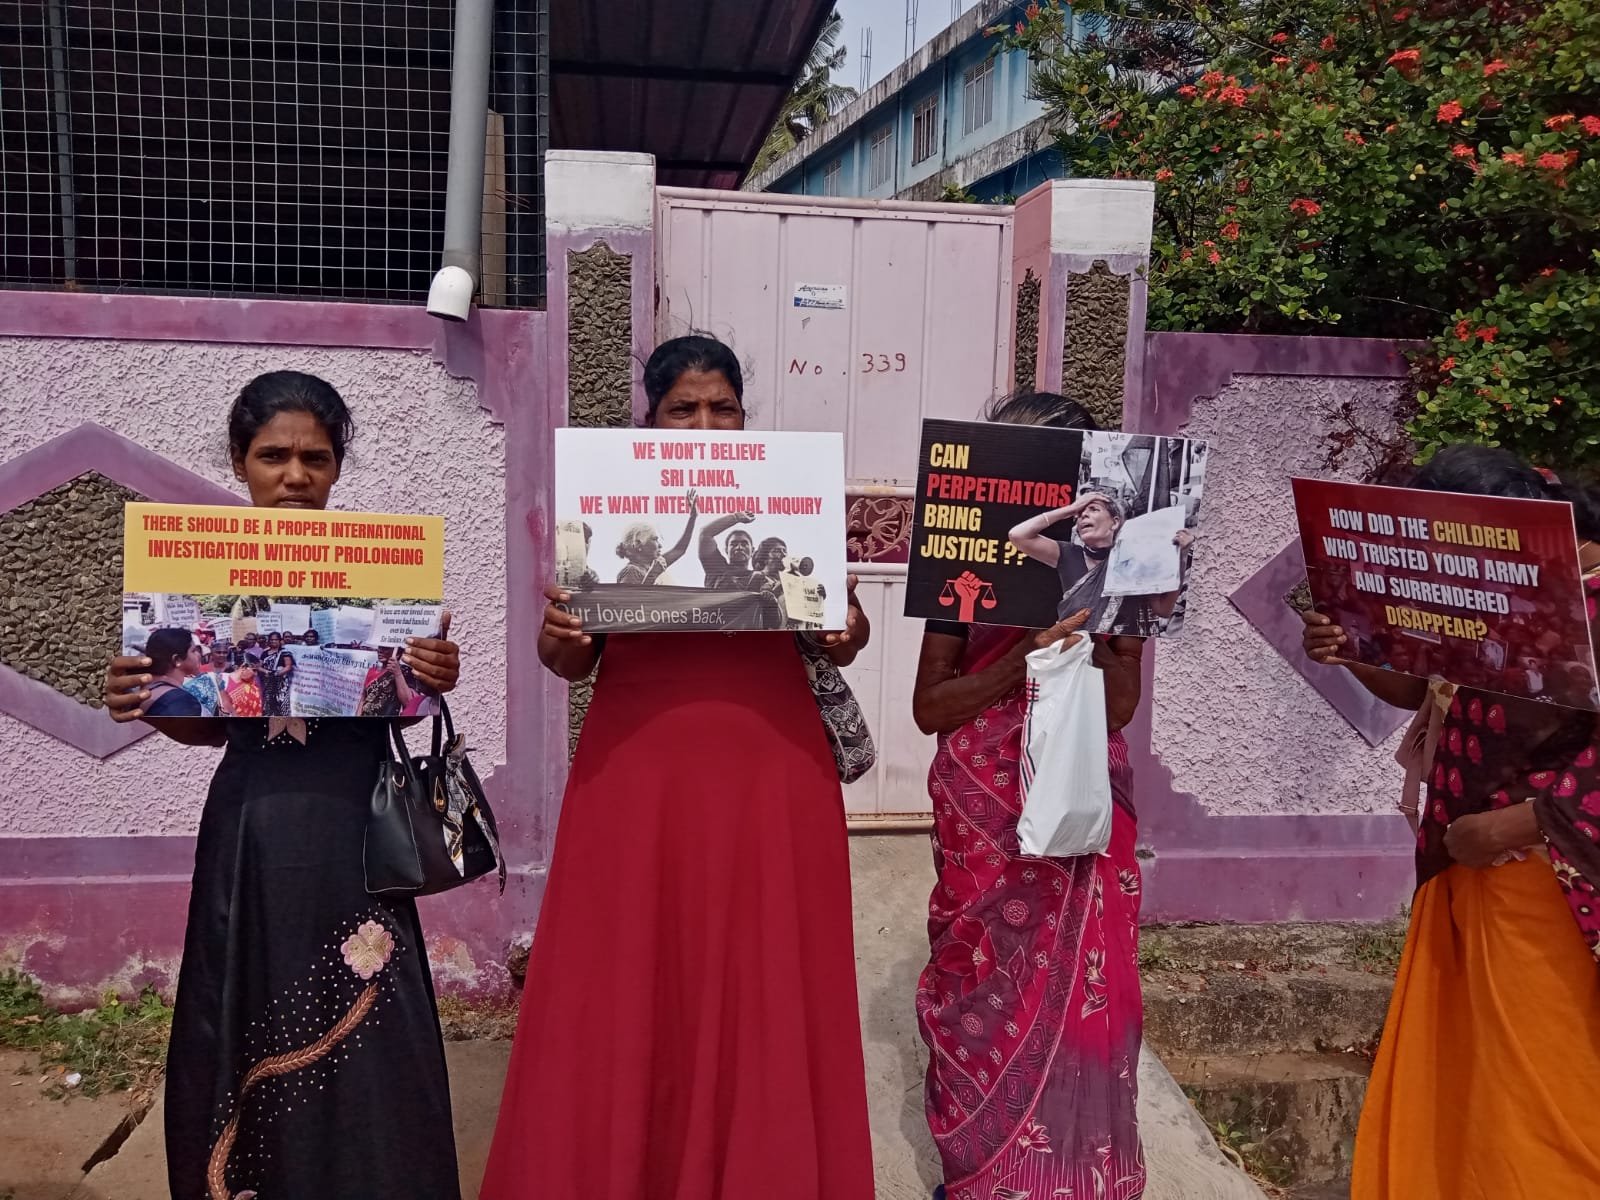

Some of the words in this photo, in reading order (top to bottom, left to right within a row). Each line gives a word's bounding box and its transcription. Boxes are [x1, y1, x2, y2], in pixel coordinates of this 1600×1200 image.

[862, 353, 906, 373] 339
[633, 442, 656, 460] WE
[660, 442, 706, 460] WON'T
[711, 443, 766, 461] BELIEVE
[930, 443, 970, 469] CAN
[660, 469, 684, 487] SRI
[689, 470, 740, 489] LANKA,
[926, 473, 1072, 508] PERPETRATORS
[579, 496, 603, 514] WE
[607, 496, 650, 514] WANT
[767, 496, 822, 515] INQUIRY
[923, 503, 982, 532] BRING
[142, 515, 183, 532] THERE
[187, 517, 239, 534] SHOULD
[243, 519, 260, 535] BE
[263, 519, 273, 535] A
[277, 520, 327, 537] PROPER
[331, 522, 426, 541] INTERNATIONAL
[1328, 508, 1363, 532] HOW
[1367, 512, 1394, 536] DID
[1397, 516, 1430, 540] THE
[1432, 520, 1521, 552] CHILDREN
[148, 539, 259, 561] INVESTIGATION
[264, 543, 330, 563] WITHOUT
[334, 545, 424, 566] PROLONGING
[920, 534, 999, 564] JUSTICE
[1322, 536, 1358, 561] WHO
[1360, 541, 1429, 572] TRUSTED
[1431, 552, 1479, 580] YOUR
[1484, 560, 1539, 587] ARMY
[229, 568, 283, 588] PERIOD
[287, 570, 306, 588] OF
[311, 571, 352, 590] TIME.
[1355, 571, 1386, 595] AND
[1390, 576, 1510, 615] SURRENDERED
[597, 603, 645, 623] loved
[650, 609, 688, 624] ones
[692, 607, 726, 625] Back.
[1385, 605, 1488, 641] DISAPPEAR?
